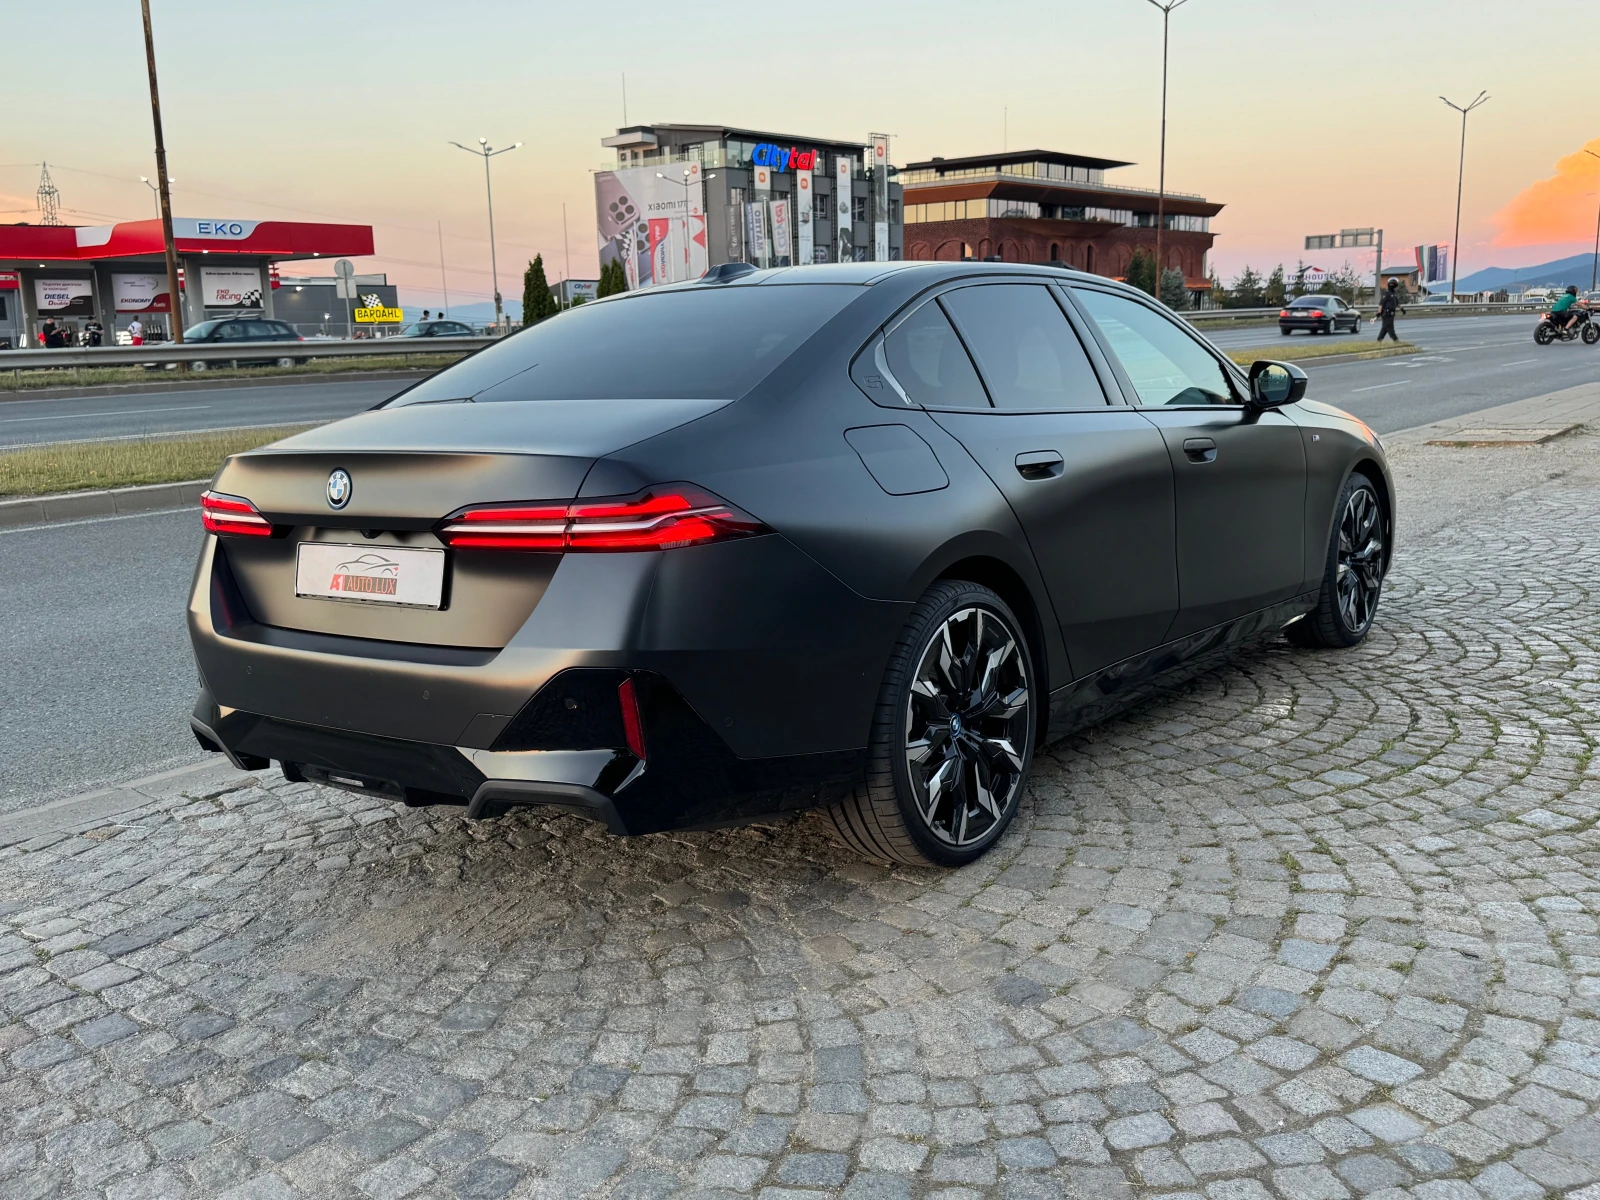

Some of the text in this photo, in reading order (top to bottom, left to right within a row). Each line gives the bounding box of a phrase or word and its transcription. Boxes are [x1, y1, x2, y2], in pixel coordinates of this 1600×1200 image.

[197, 222, 243, 235] EKO
[216, 293, 241, 302] racing
[357, 309, 400, 319] BARDAHL
[329, 574, 396, 595] A1 AUTO LUX
